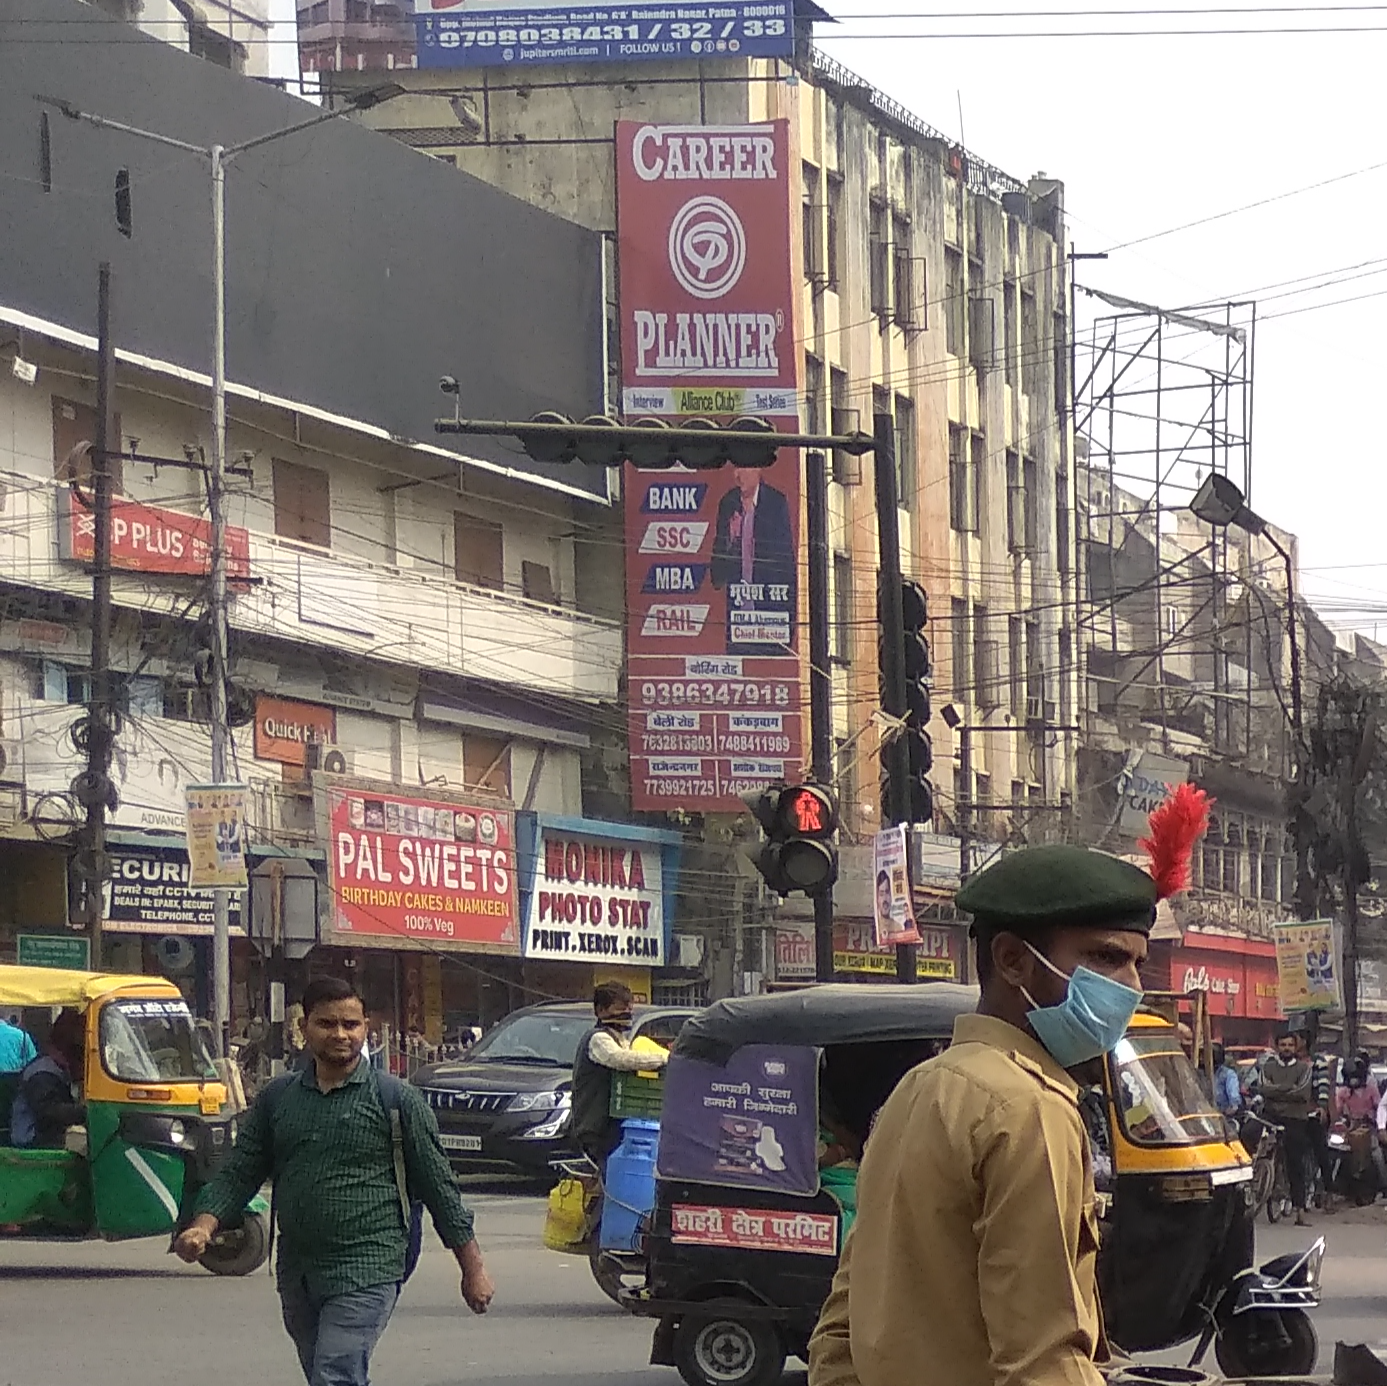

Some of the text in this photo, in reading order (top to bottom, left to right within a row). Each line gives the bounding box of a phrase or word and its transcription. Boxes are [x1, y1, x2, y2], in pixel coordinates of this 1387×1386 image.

[708, 8, 737, 18] Patna
[670, 22, 713, 38] 32
[743, 19, 786, 36] 33
[620, 44, 660, 54] FOLLOW
[661, 43, 675, 53] US
[633, 125, 777, 181] CAREER
[632, 393, 666, 409] Interview
[681, 391, 714, 412] Alliance
[650, 487, 697, 510] BANK
[132, 521, 184, 558] PLUS
[656, 526, 691, 549] SSC
[655, 567, 695, 590] MBA
[656, 609, 697, 631] RAIL
[641, 682, 790, 706] 9386347918
[264, 717, 301, 743] Quick
[338, 831, 508, 895] PAL SWEETS
[545, 838, 646, 892] MONIKA
[114, 896, 140, 906] DEALS
[182, 900, 214, 910] SECURIT
[341, 886, 510, 917] BIRTHDAY CAKES & NAMKEEN
[538, 890, 652, 930] PHOTO STAT
[140, 910, 197, 922] TELEPHONE,
[404, 914, 455, 936] 100% Veg
[711, 1082, 751, 1096] आपकी
[703, 1096, 737, 1110] हमारी
[674, 1207, 724, 1234] शहरी
[771, 1214, 832, 1242] परमिट
